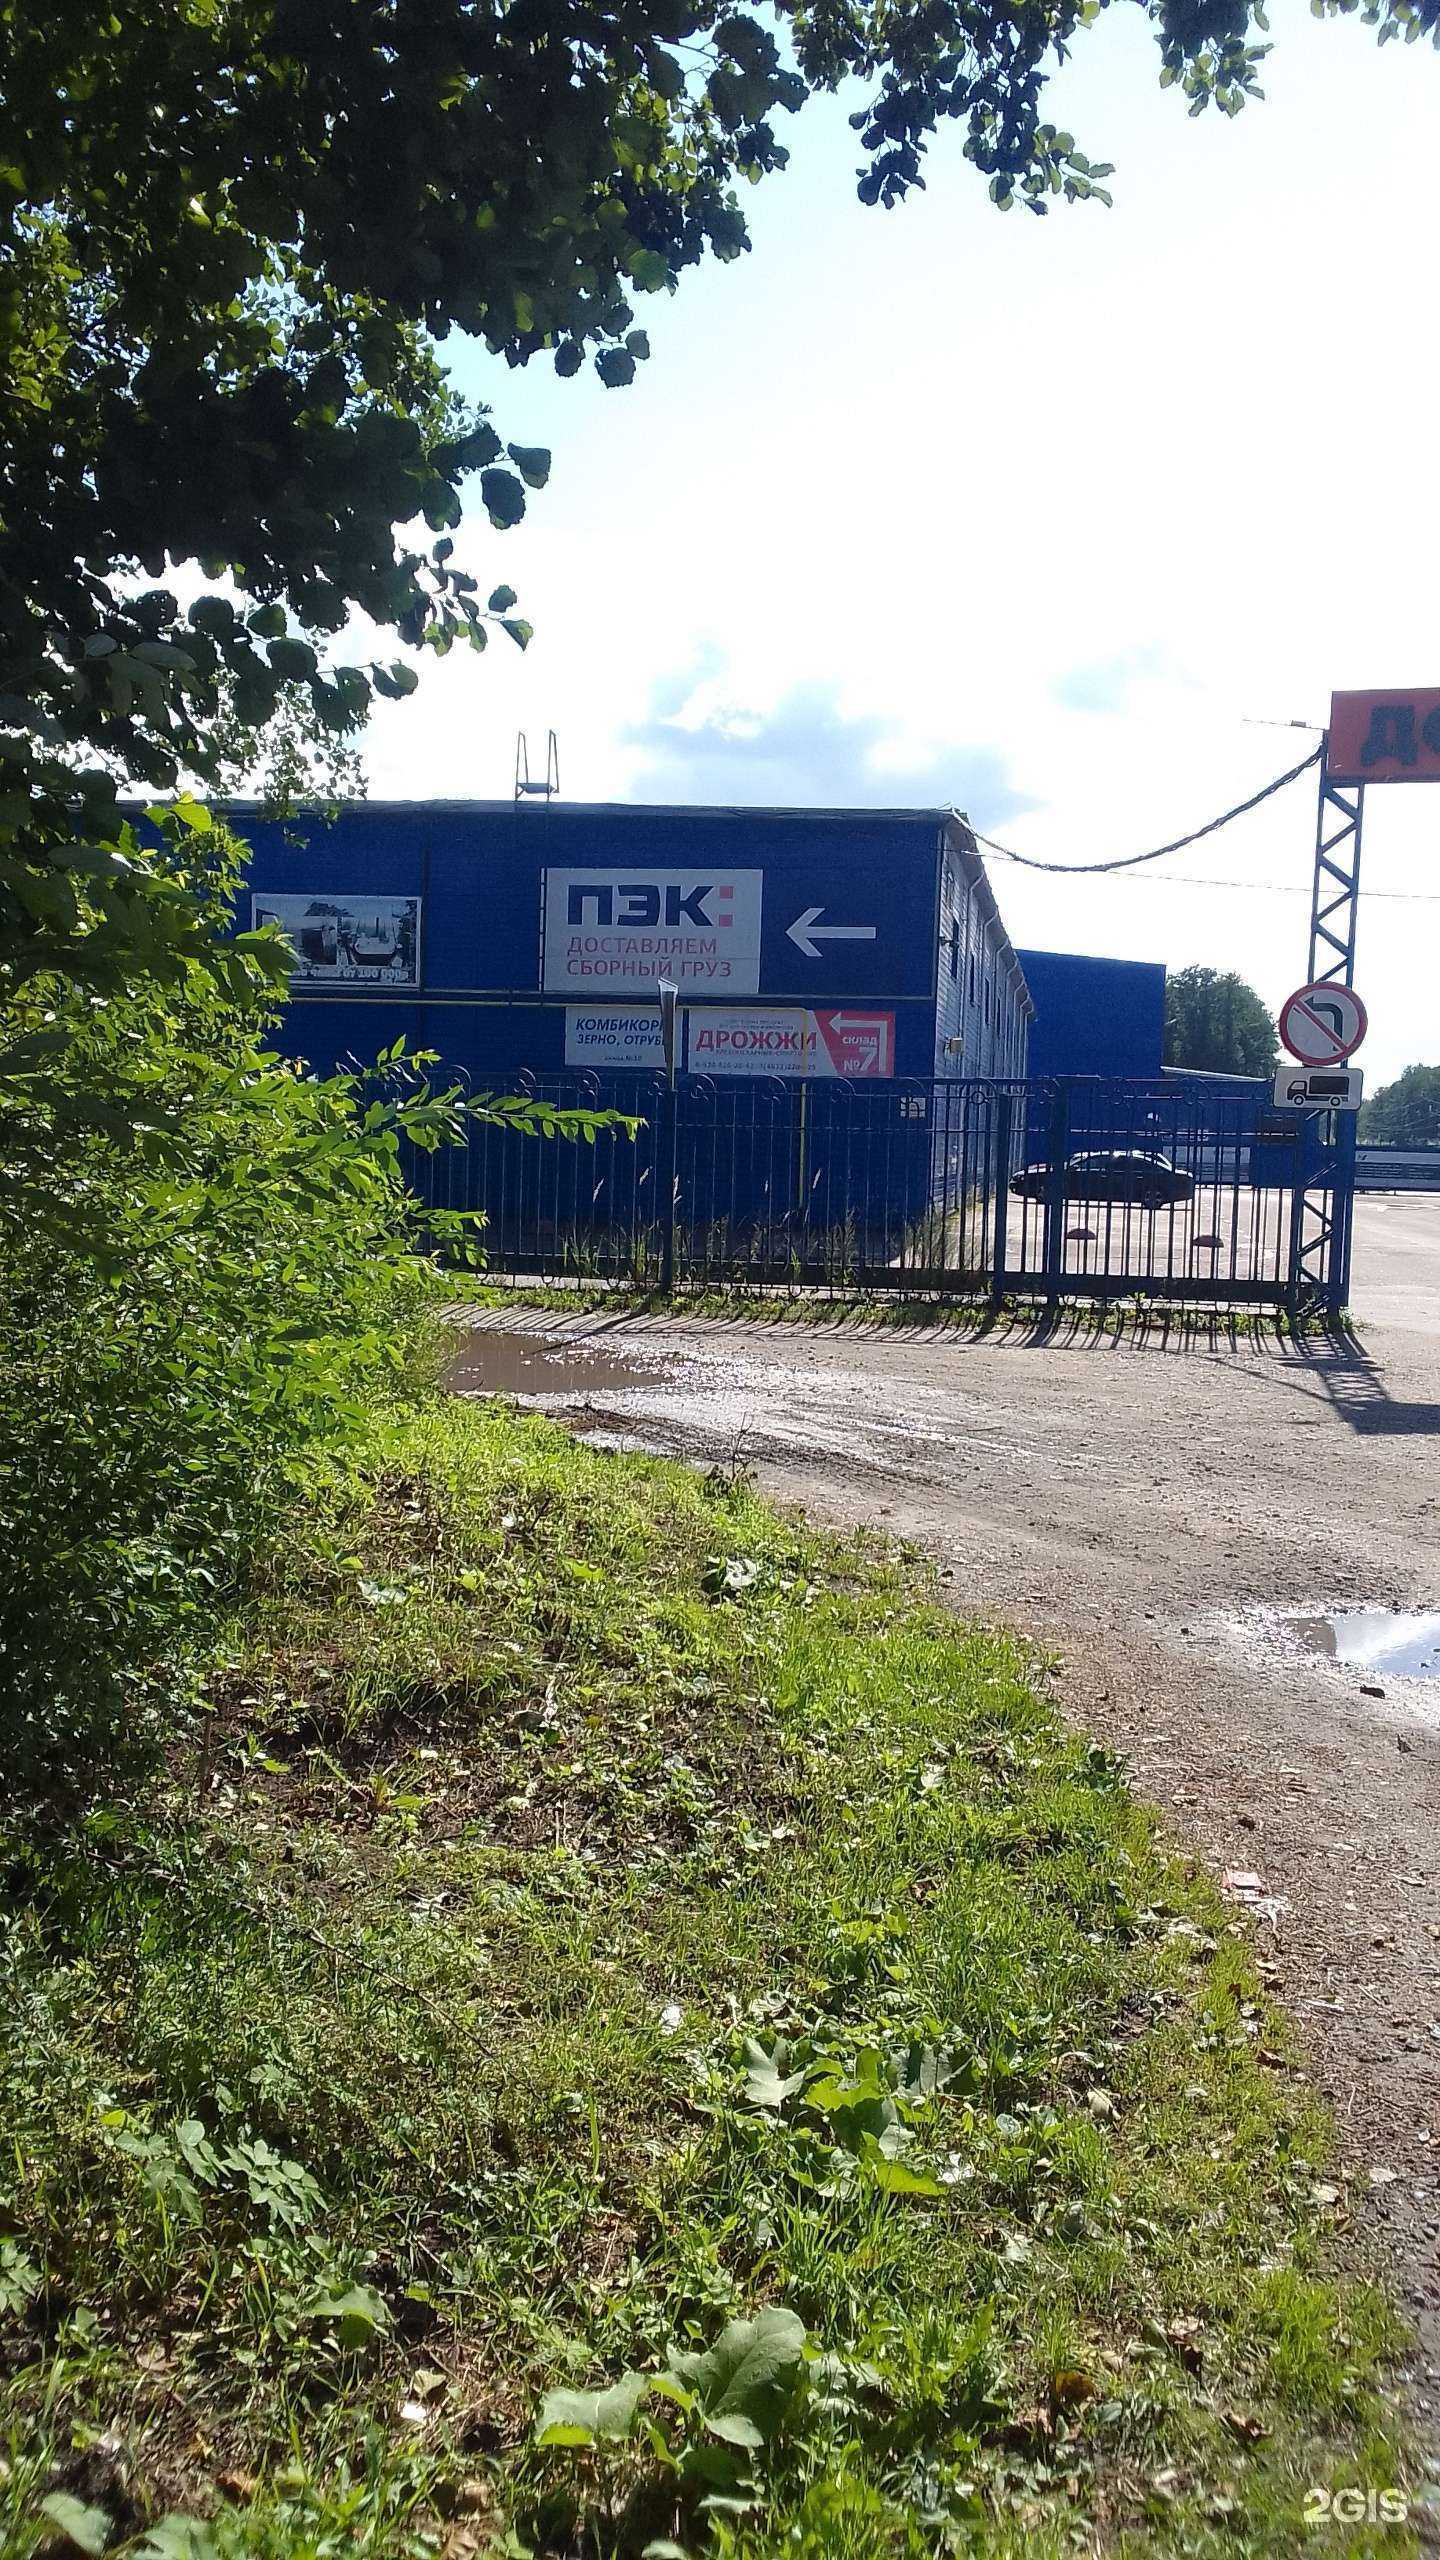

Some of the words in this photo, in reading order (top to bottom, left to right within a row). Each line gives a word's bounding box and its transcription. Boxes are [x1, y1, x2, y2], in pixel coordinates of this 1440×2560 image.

[567, 937, 717, 956] ДОСТАВЛЯЕМ
[567, 957, 672, 977] СБОРНЫЙ
[681, 961, 732, 977] ГРУЗ
[577, 1034, 620, 1046] ЗЕРНО,
[696, 1030, 817, 1052] ДРОЖЖИ
